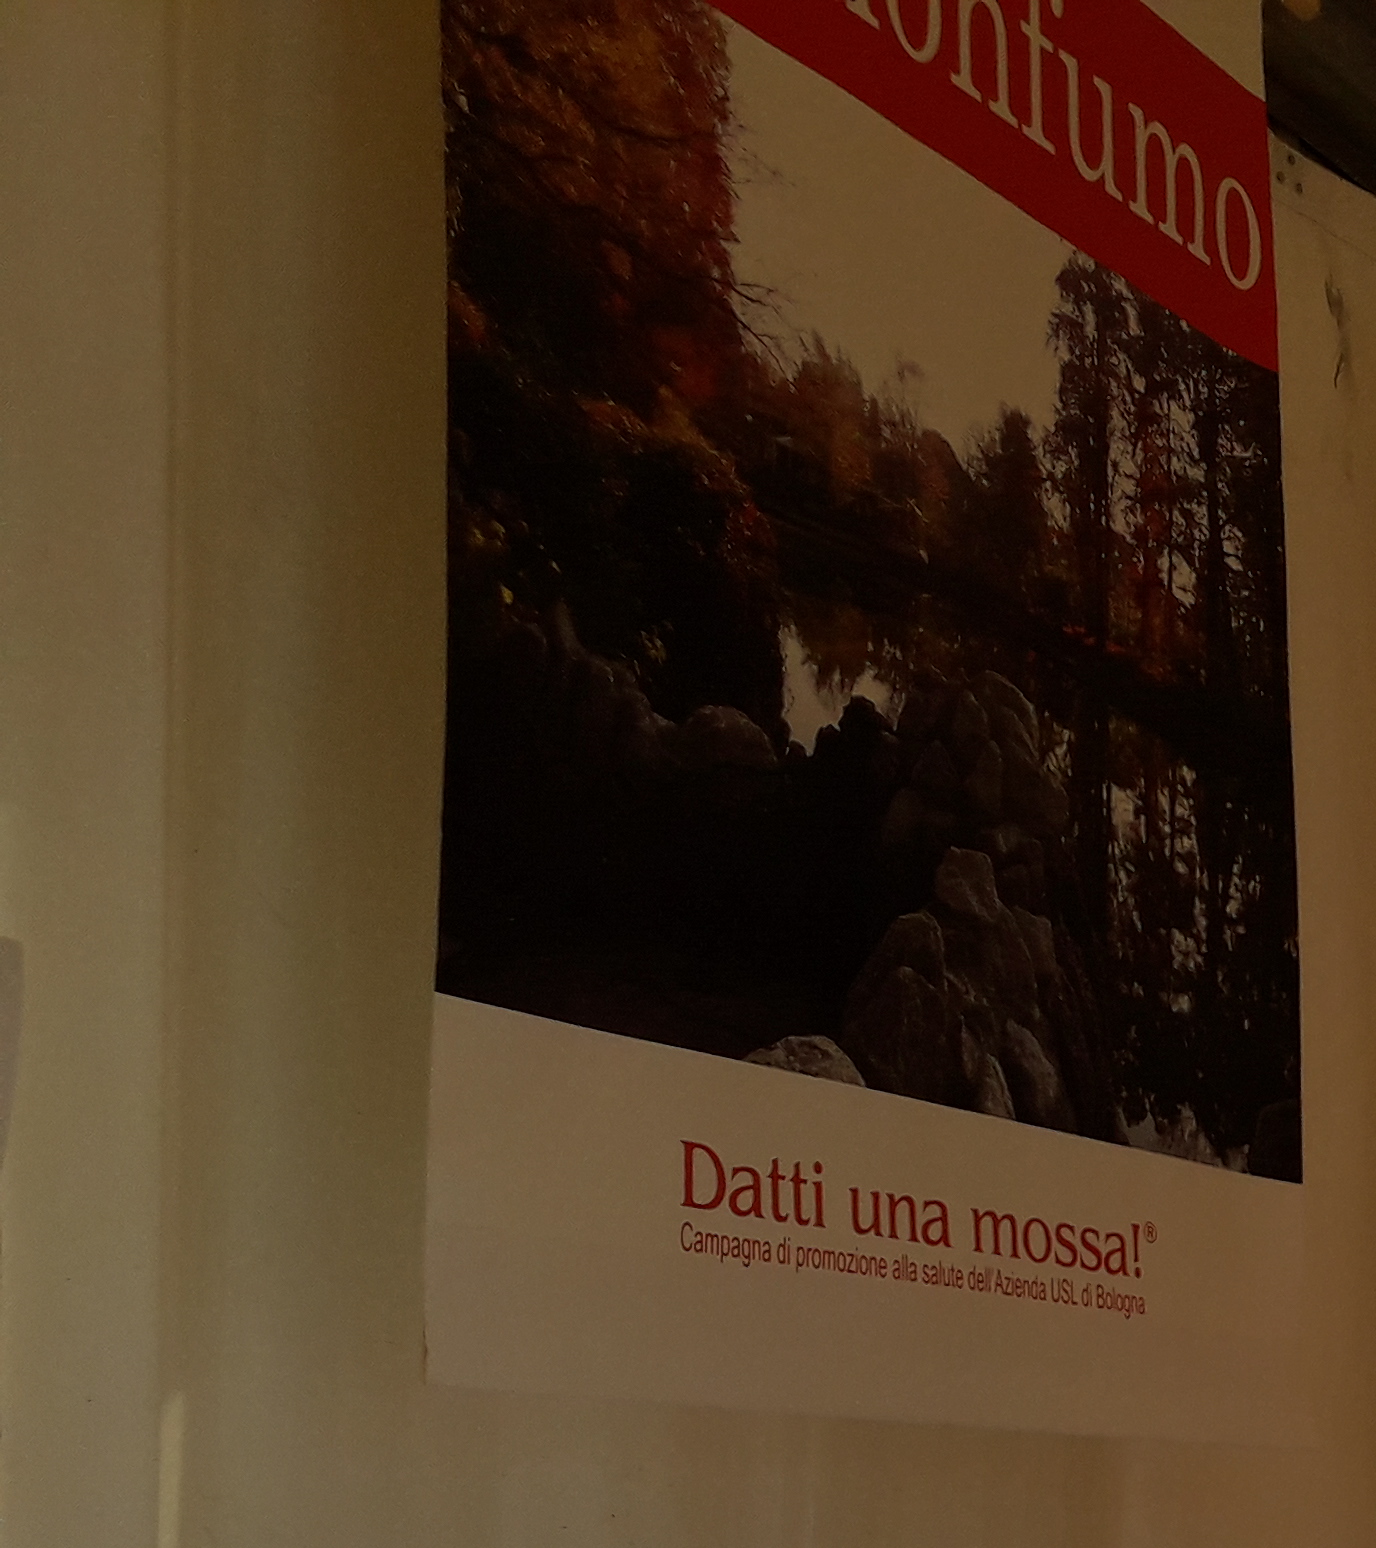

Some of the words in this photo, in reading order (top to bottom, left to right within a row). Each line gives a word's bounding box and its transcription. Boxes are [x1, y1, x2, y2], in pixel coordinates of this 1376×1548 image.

[680, 1140, 826, 1228] Datti
[848, 1185, 951, 1248] una
[680, 1221, 771, 1267] Campagna
[776, 1236, 791, 1264] di
[796, 1245, 888, 1279] promozione
[893, 1254, 918, 1283] alla
[922, 1260, 964, 1289] salute
[1051, 1277, 1077, 1306] USL
[1081, 1282, 1093, 1308] di
[1096, 1285, 1146, 1319] Bologna
